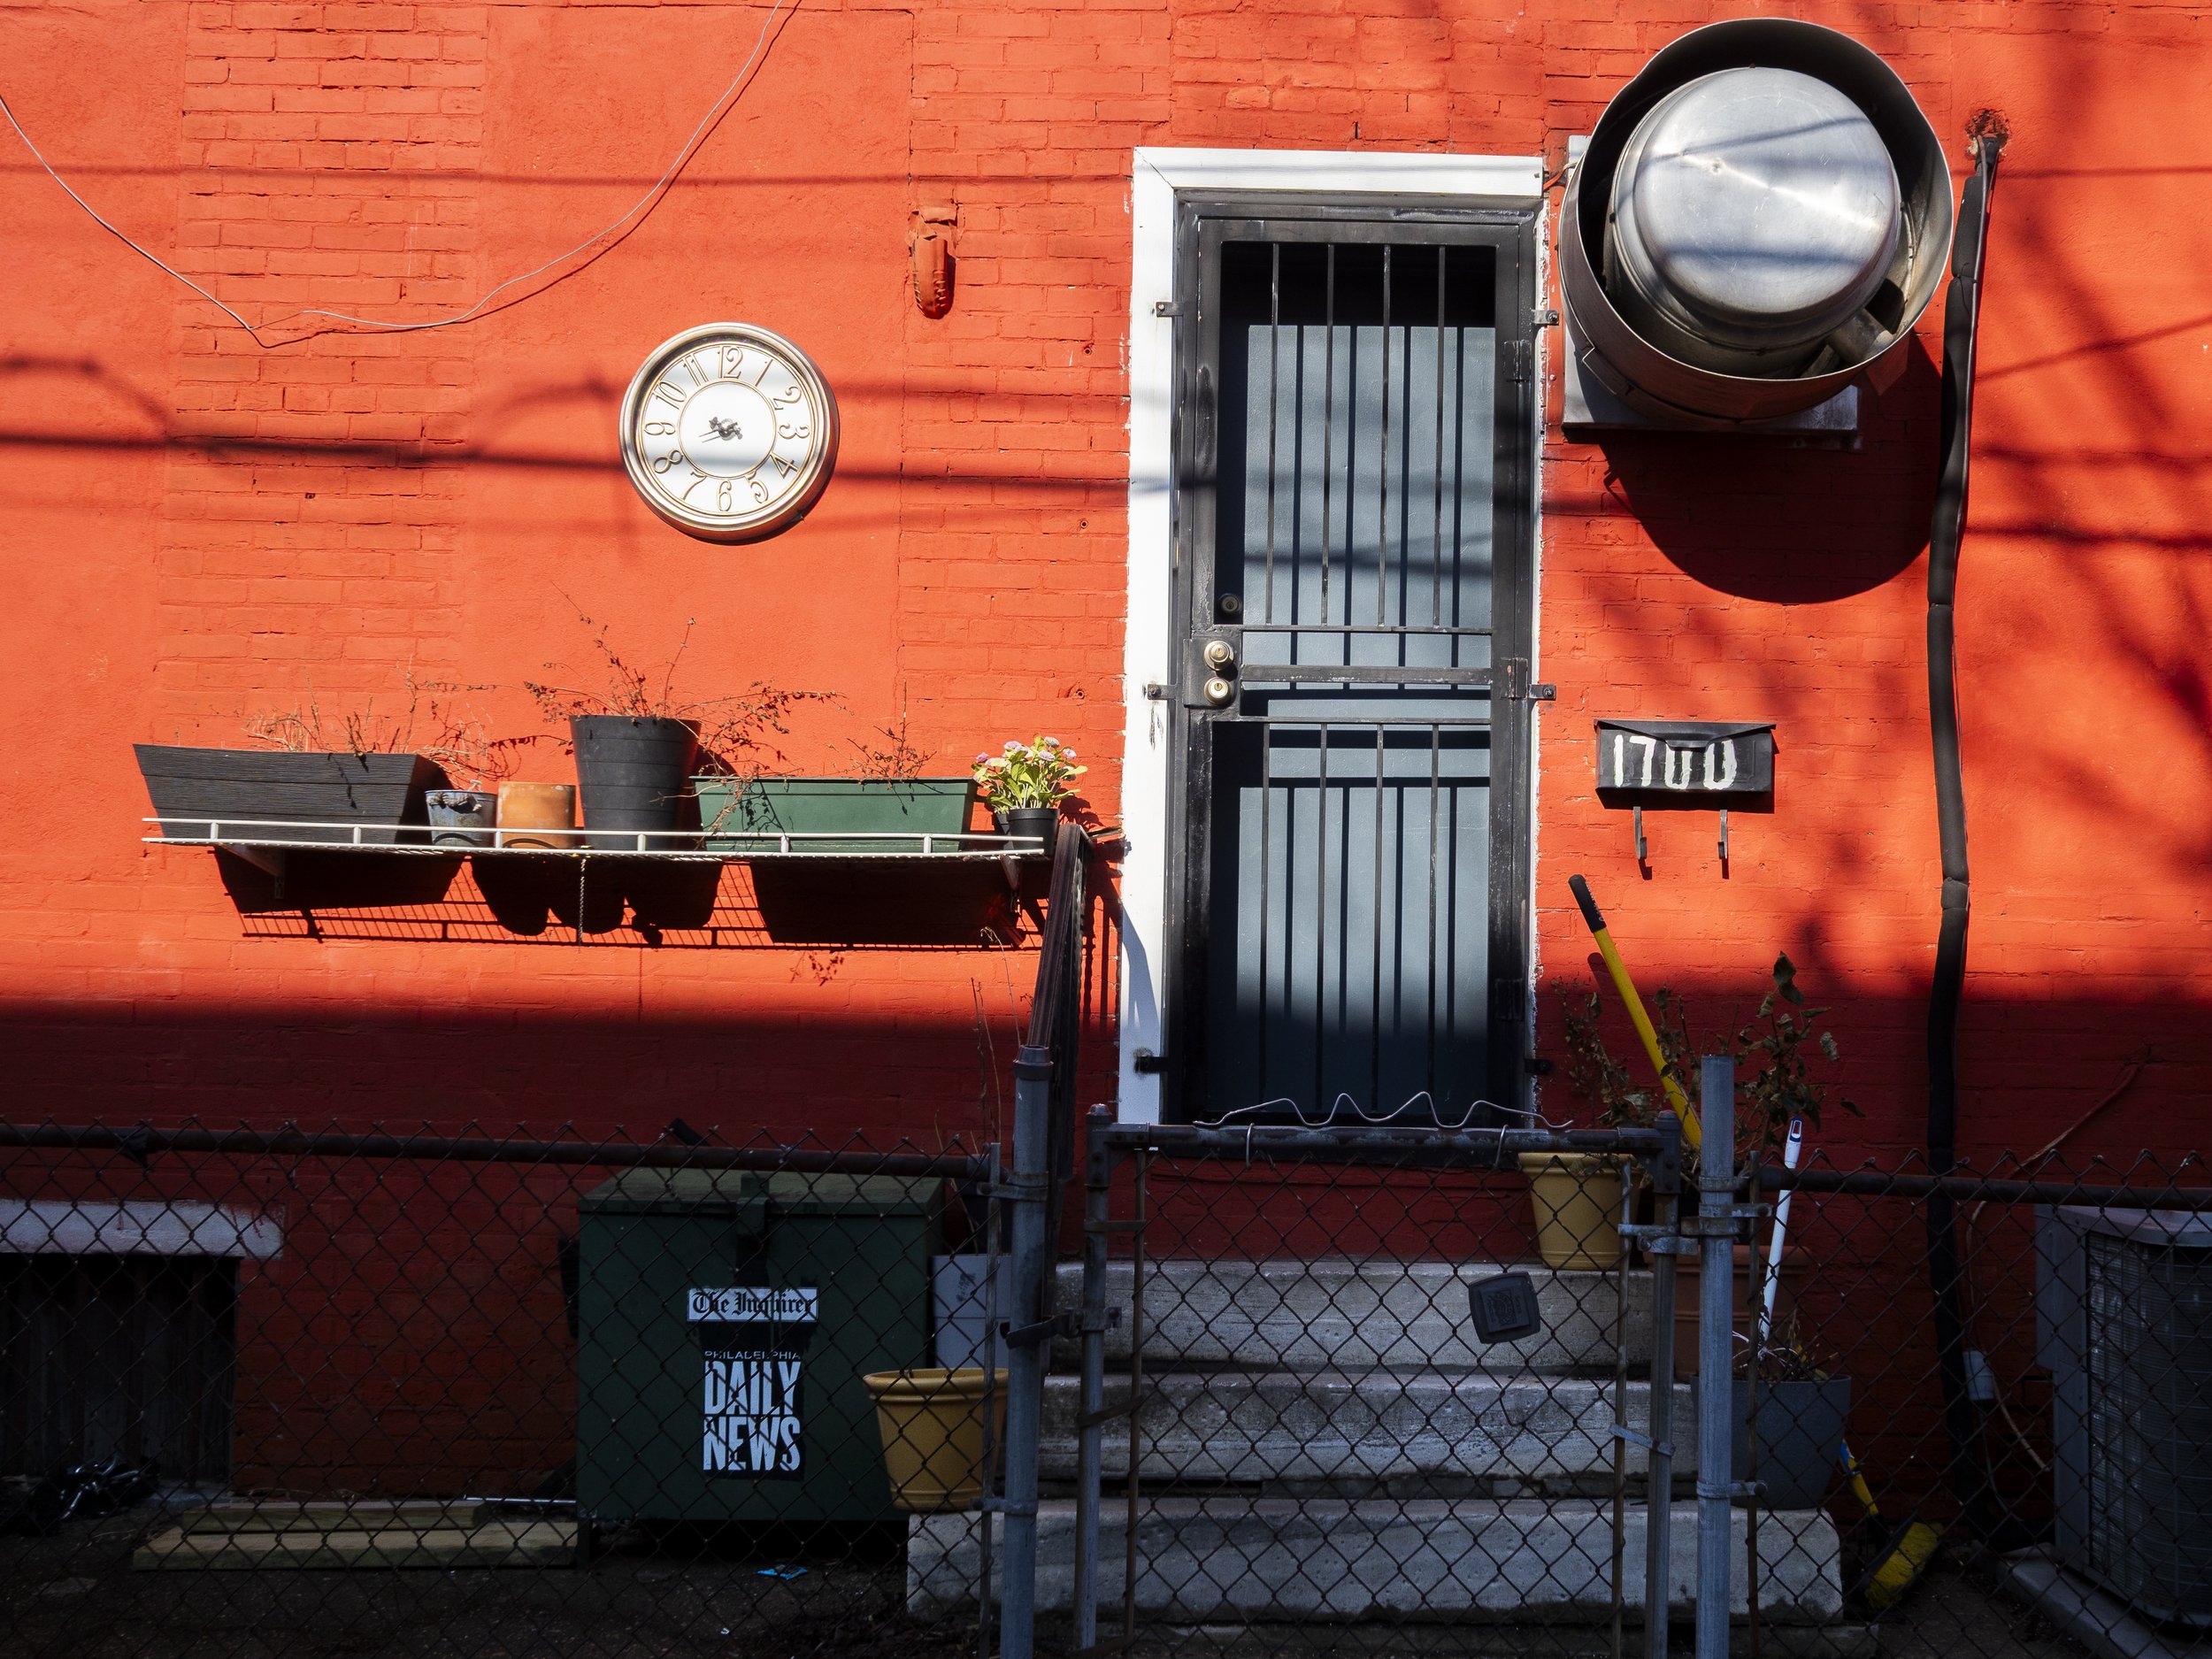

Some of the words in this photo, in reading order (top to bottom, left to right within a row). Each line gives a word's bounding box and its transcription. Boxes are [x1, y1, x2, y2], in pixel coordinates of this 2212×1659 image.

[683, 353, 709, 387] 11
[718, 345, 744, 380] 12
[755, 358, 773, 388] 1
[651, 380, 687, 410] 10
[773, 386, 802, 411] 2
[643, 421, 676, 436] 9
[778, 424, 810, 440] 3
[653, 449, 684, 474] 8
[769, 451, 799, 479] 4
[680, 471, 707, 501] 7
[717, 480, 733, 512] 6
[744, 471, 769, 504] 5
[1614, 734, 1737, 790] 1700
[692, 1291, 730, 1314] The
[704, 1350, 802, 1360] PHILADELPHIA
[704, 1361, 802, 1415] DAILY
[703, 1416, 801, 1471] NEWS
